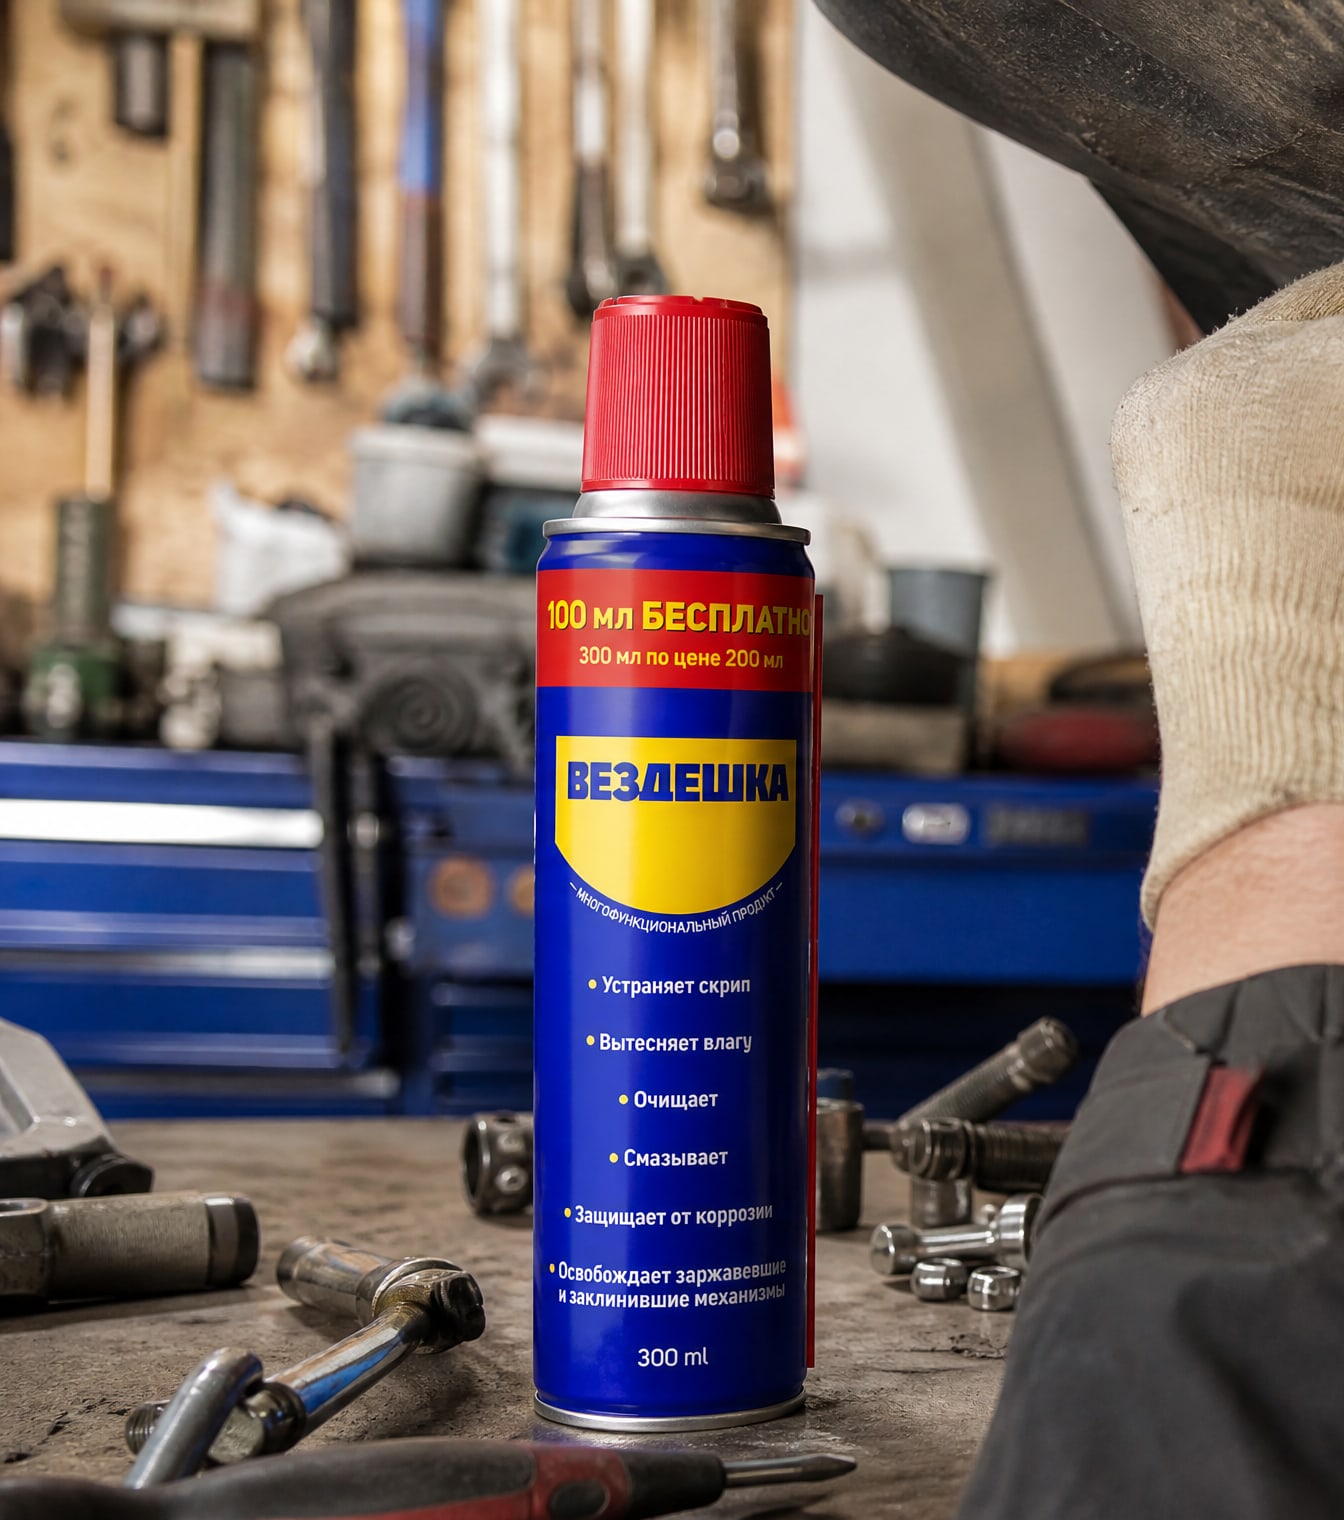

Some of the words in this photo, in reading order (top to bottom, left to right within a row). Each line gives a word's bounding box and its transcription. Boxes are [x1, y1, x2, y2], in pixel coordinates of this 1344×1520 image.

[548, 600, 586, 630] 100
[594, 607, 633, 630] мл
[642, 601, 810, 636] БЕСПЛАТНО
[579, 647, 612, 665] 300
[616, 650, 641, 665] мл
[646, 651, 670, 666] по
[674, 651, 721, 669] цене
[725, 649, 760, 668] 200
[764, 654, 783, 669] мл
[568, 761, 788, 802] ВЕЗДЕШКА
[576, 887, 731, 934] МНОГОФУНКЦИОНАЛЬНЫЙ
[732, 887, 776, 921] ПРОДУКТ
[602, 976, 695, 997] Устраняет
[699, 978, 751, 997] скрип
[600, 1034, 698, 1052] Вытесняет
[704, 1035, 752, 1054] влагу
[634, 1091, 718, 1110] Очищает
[624, 1149, 728, 1167] Смазывает
[575, 1206, 666, 1228] Защищает
[671, 1209, 690, 1225] от
[696, 1204, 773, 1228] коррозии
[558, 1261, 670, 1285] Освобождает
[675, 1259, 787, 1284] заржавевшие
[558, 1289, 566, 1305] и
[569, 1288, 689, 1308] заклинившие
[694, 1284, 786, 1306] механизмы
[638, 1348, 678, 1367] 300
[684, 1347, 709, 1366] ml
